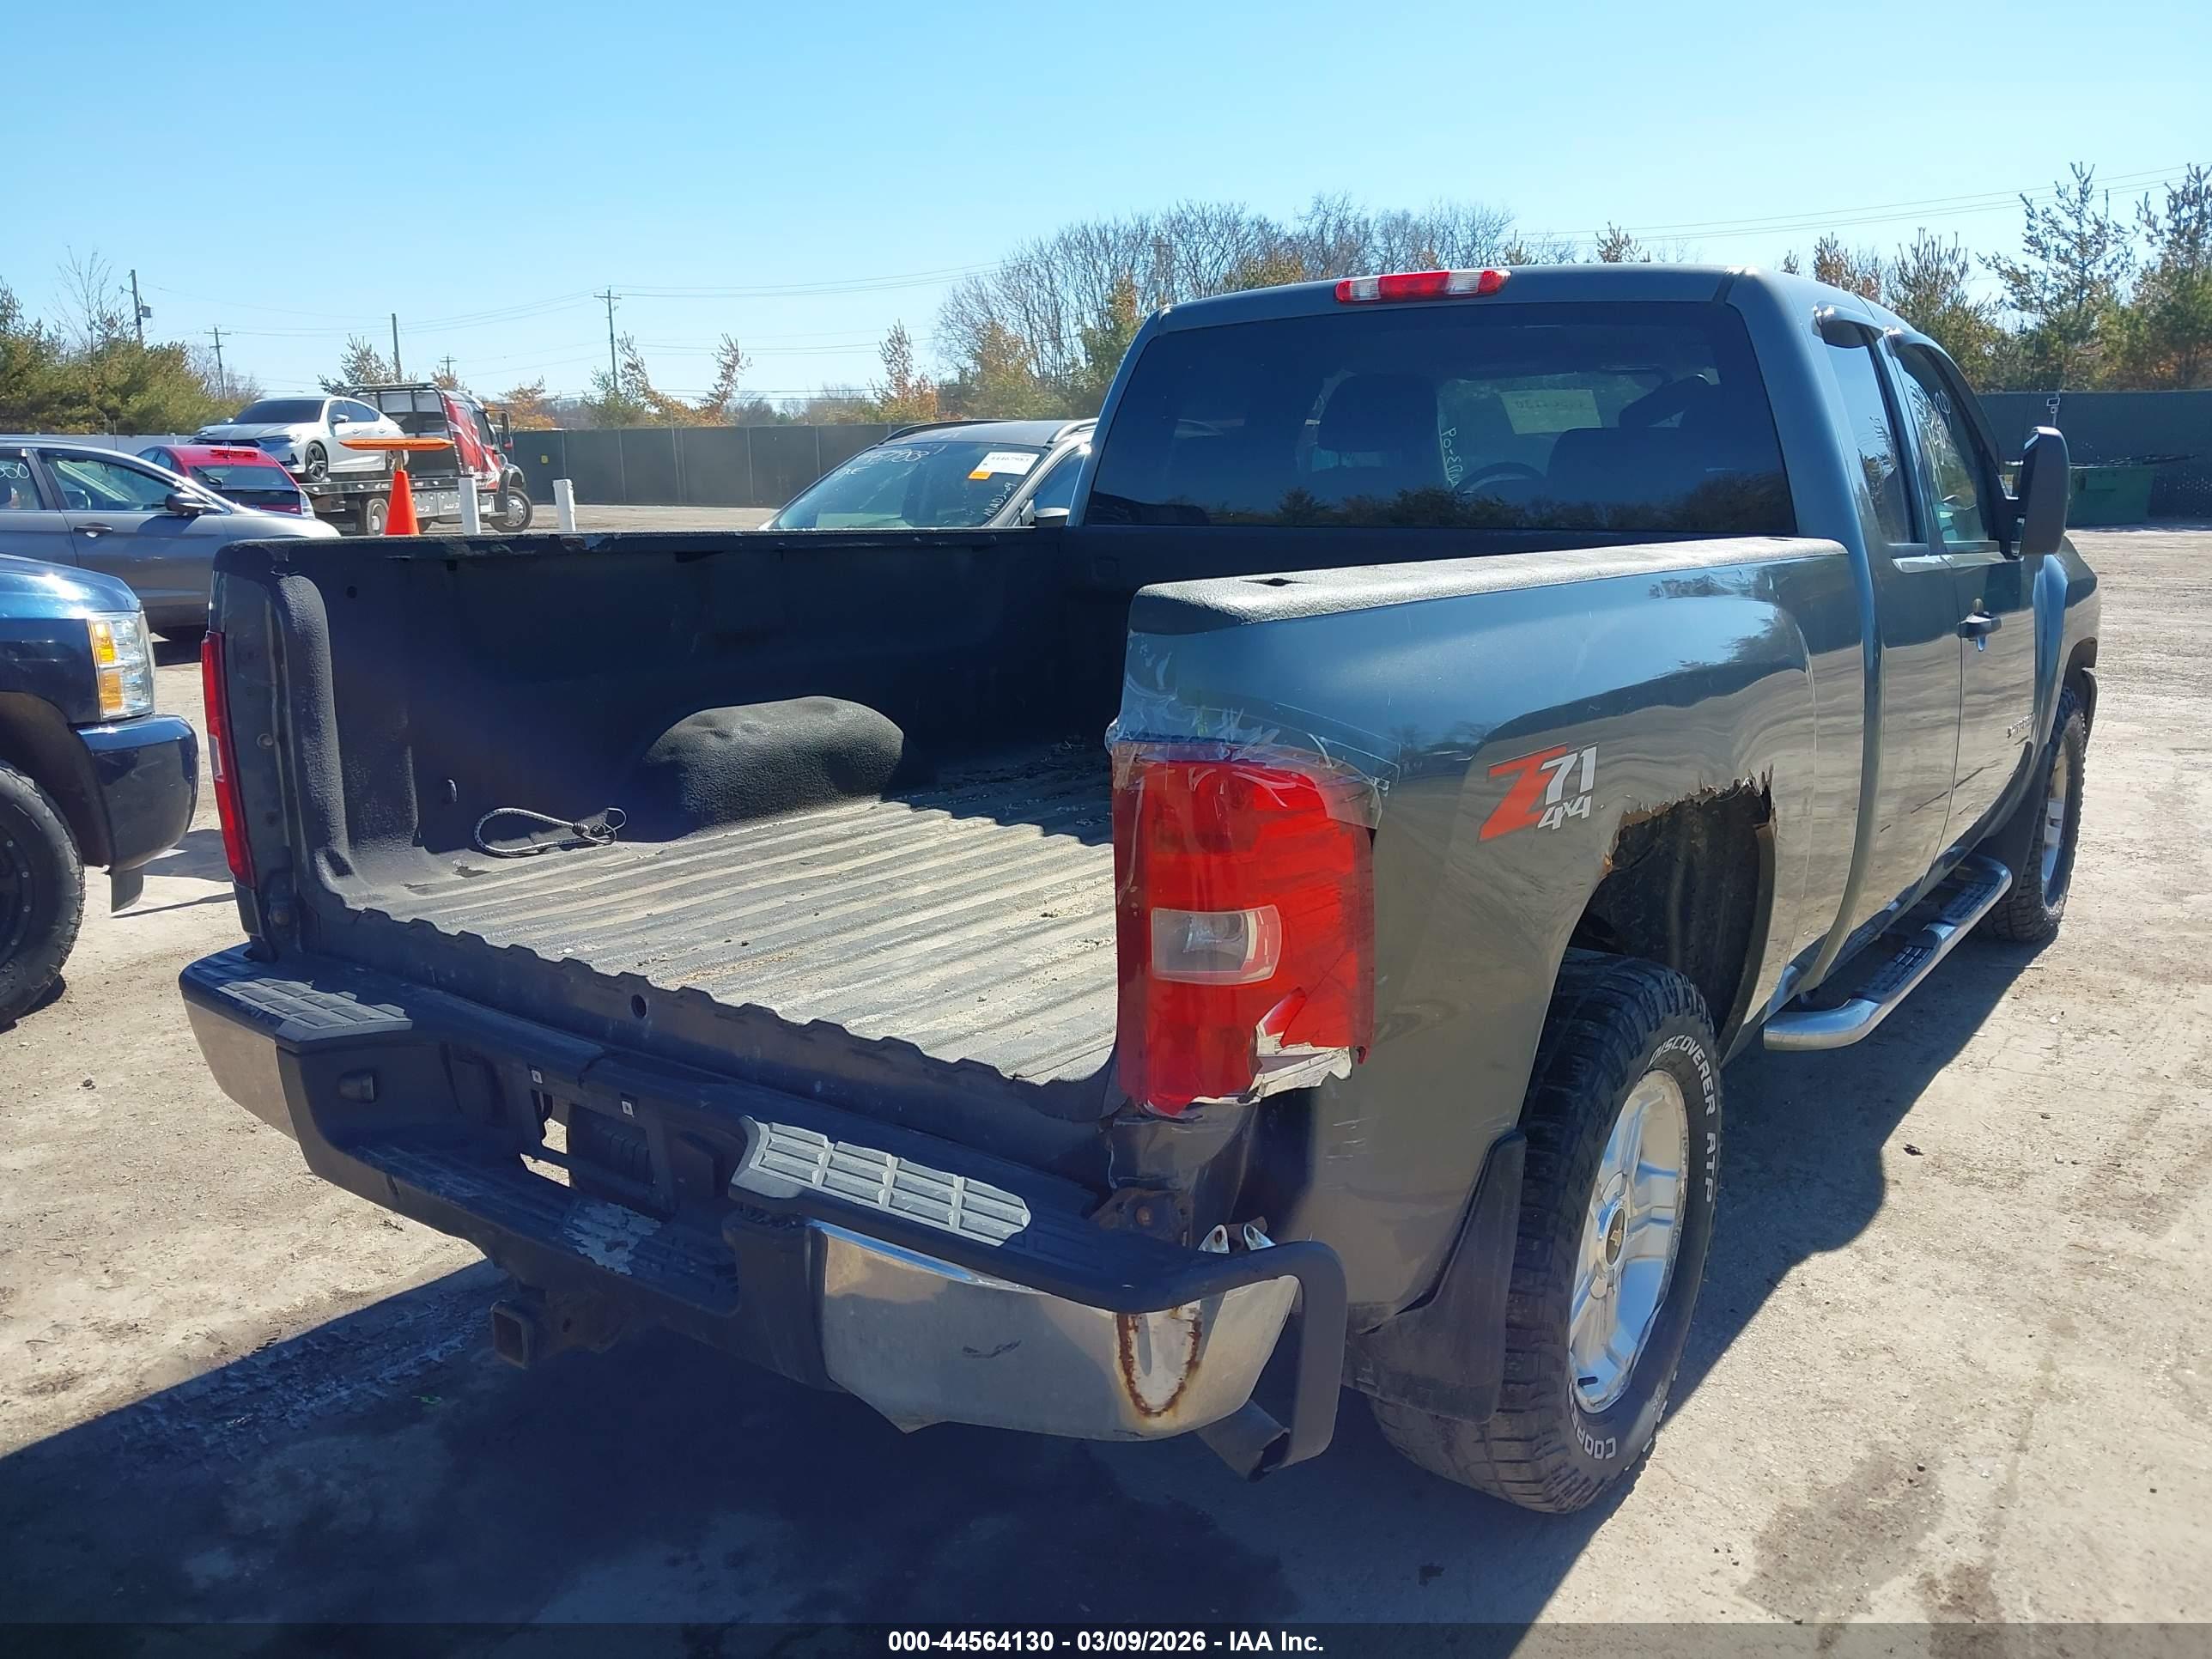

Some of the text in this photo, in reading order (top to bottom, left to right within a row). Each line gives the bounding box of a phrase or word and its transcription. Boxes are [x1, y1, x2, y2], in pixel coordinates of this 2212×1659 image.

[1480, 741, 1599, 842] Z71
[1648, 1034, 1717, 1203] DISCOVERER ATP
